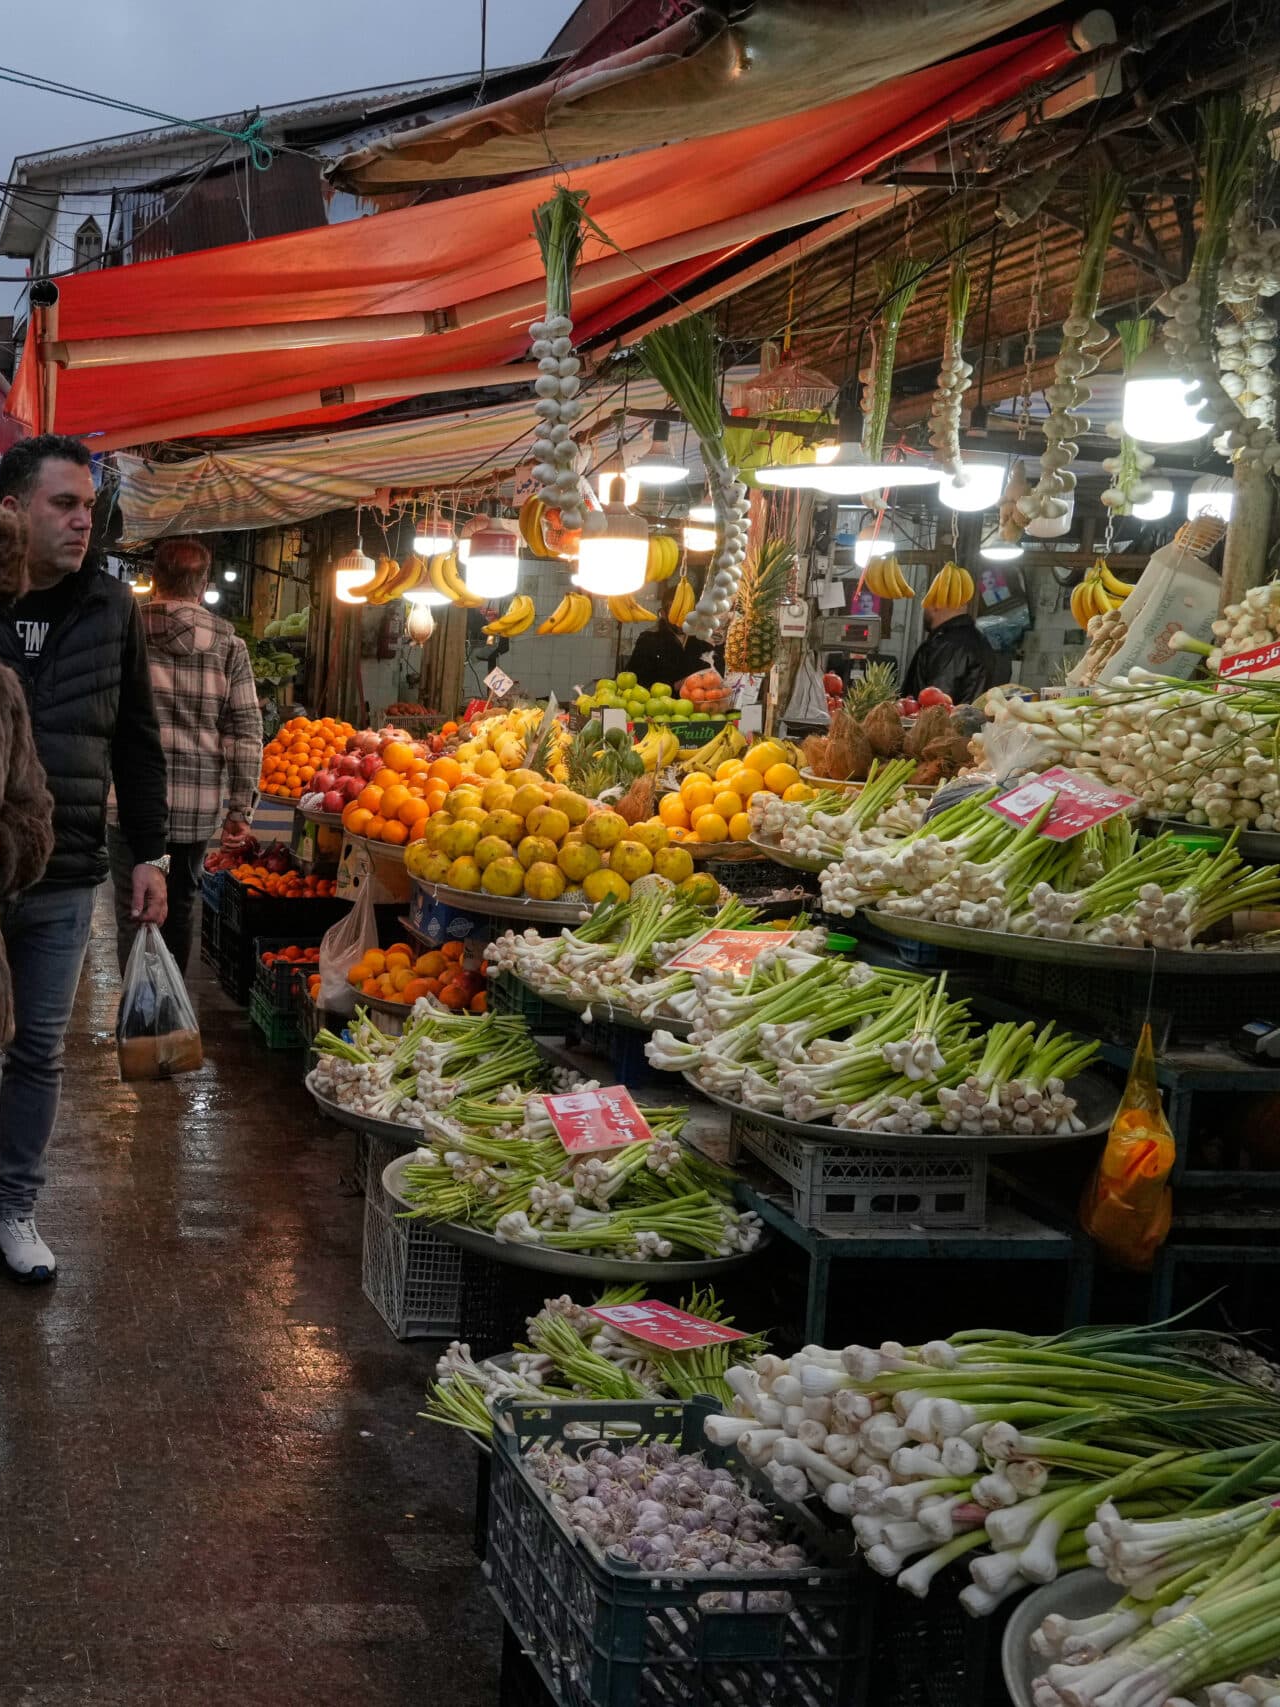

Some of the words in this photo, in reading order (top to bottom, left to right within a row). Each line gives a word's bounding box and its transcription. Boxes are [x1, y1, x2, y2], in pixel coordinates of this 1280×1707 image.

[1220, 658, 1255, 677] محلی
[599, 1093, 622, 1113] محلی
[609, 1110, 636, 1126] تازه
[615, 1127, 638, 1140] سیر
[641, 1305, 682, 1322] محلی
[679, 1318, 712, 1332] تازه
